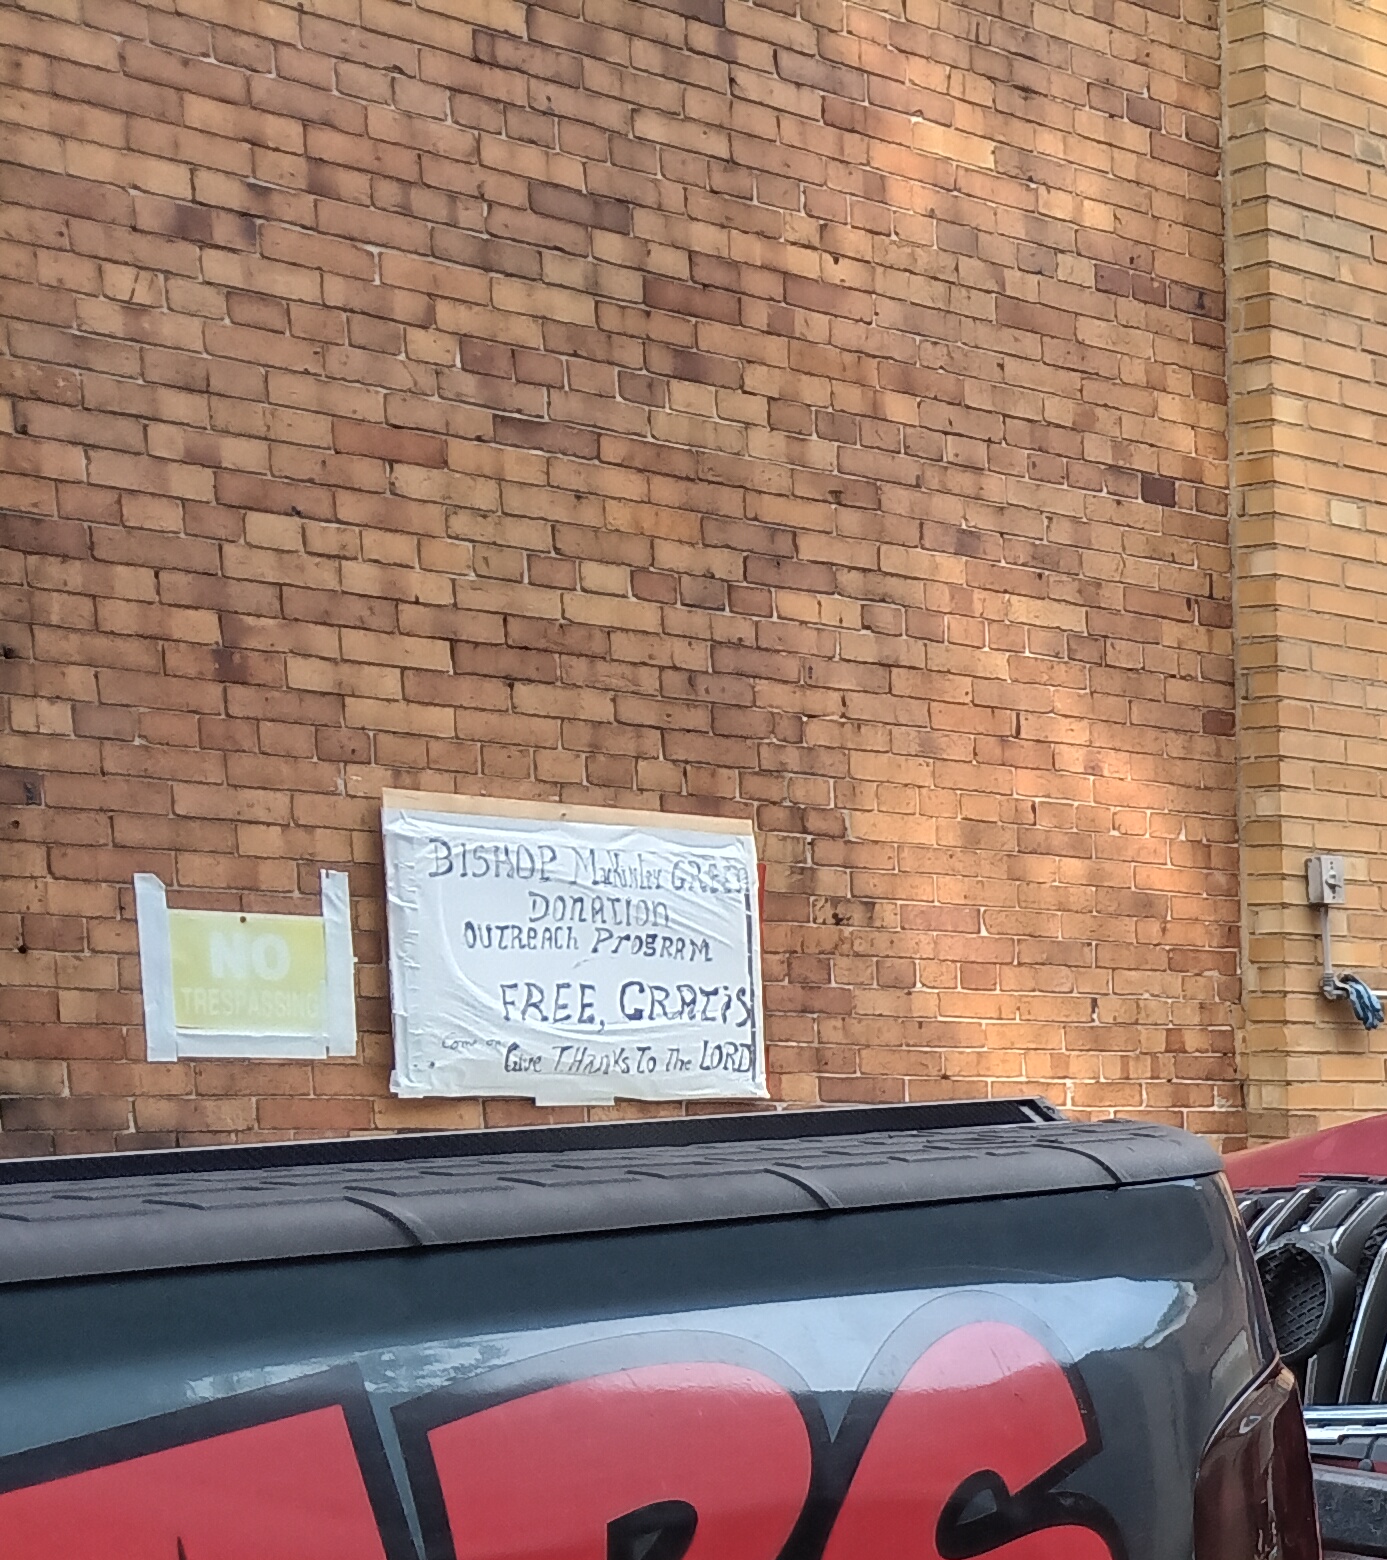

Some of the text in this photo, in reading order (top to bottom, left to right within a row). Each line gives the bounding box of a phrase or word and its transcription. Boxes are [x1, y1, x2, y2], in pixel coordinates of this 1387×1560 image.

[428, 837, 557, 882] BISHOP
[208, 930, 291, 982] NO
[180, 986, 320, 1018] TRESPASSING
[499, 981, 606, 1033] FREE,
[635, 1045, 657, 1074] To
[665, 1046, 693, 1073] The
[699, 1039, 751, 1074] LORD
